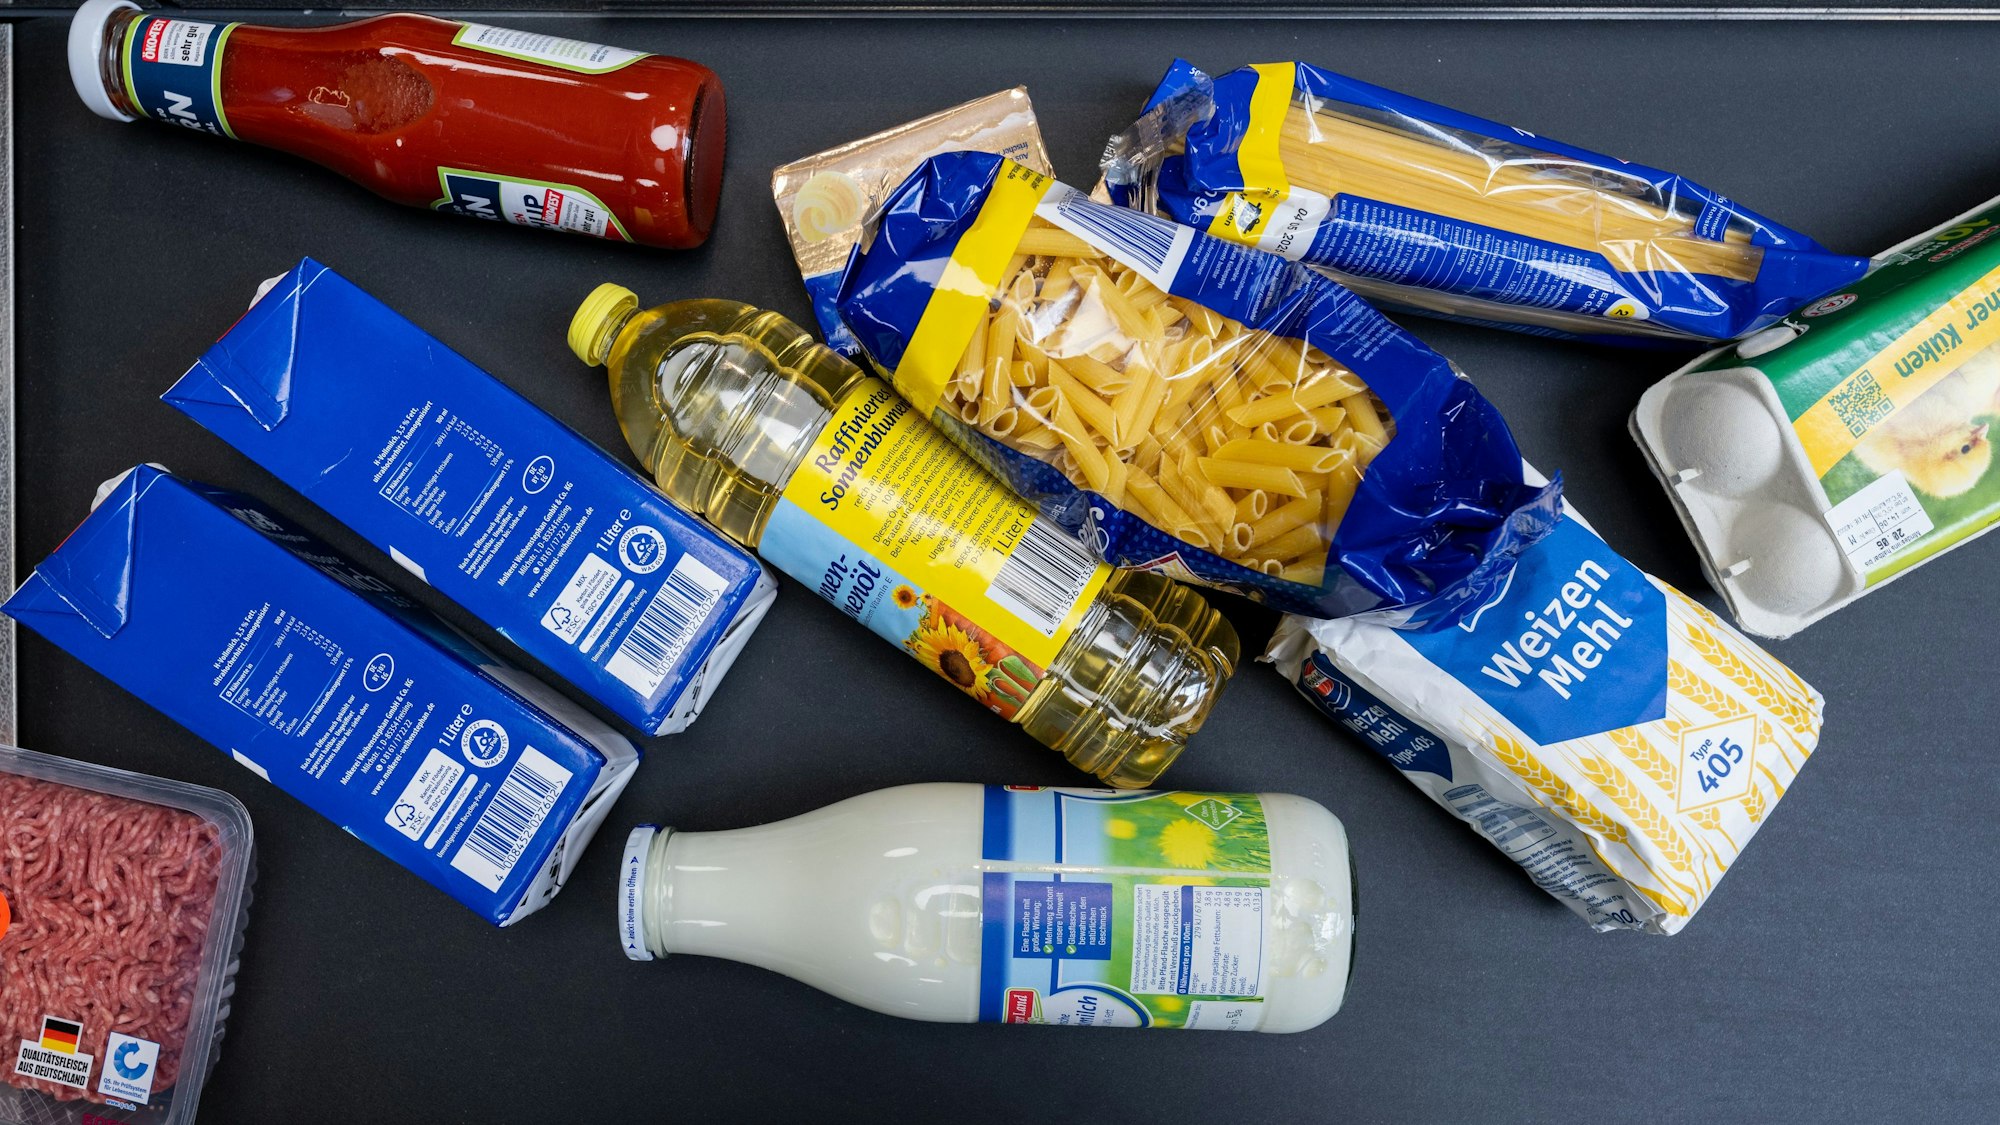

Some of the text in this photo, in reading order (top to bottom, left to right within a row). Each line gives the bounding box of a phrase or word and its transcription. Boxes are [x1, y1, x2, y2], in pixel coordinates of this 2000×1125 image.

[180, 25, 198, 60] sehr gut
[1292, 207, 1308, 221] 04
[1892, 322, 1963, 379] Küken
[813, 387, 891, 474] Raffiniertes
[528, 465, 537, 474] DE
[553, 503, 572, 527] Freising
[872, 517, 892, 543] Dieses
[909, 473, 922, 488] sich
[882, 518, 904, 547] Braten
[900, 501, 915, 519] und
[912, 485, 927, 503] zum
[889, 543, 902, 558] Bei
[937, 475, 949, 489] und
[910, 524, 927, 545] Nach
[934, 477, 960, 509] Gebrauch
[496, 559, 519, 587] Molkerei
[513, 519, 549, 563] Weihenstephan
[542, 503, 558, 522] GmbH
[558, 489, 568, 500] Co.
[563, 481, 573, 491] KG
[595, 517, 625, 553] 1 Liter
[969, 512, 995, 545] ZENTRALE
[992, 515, 1025, 556] 1 Liter
[527, 505, 595, 598] www.molkerei-weihenstephan.de
[575, 574, 587, 588] MIX
[595, 572, 617, 601] C014047
[1044, 627, 1053, 635] 4
[1075, 556, 1099, 587] 413256
[564, 614, 581, 635] FSC
[1479, 557, 1610, 687] Weizen
[647, 595, 715, 689] 4 008452 027602
[1537, 598, 1633, 700] Mehl
[394, 700, 414, 723] Freising
[1341, 704, 1388, 733] Weizen
[339, 758, 361, 786] Molkerei
[356, 716, 390, 762] Weihenstephan
[384, 700, 401, 719] GmbH
[399, 686, 408, 696] Co.
[404, 677, 414, 688] KG
[437, 712, 466, 748] 1 Liter
[1366, 717, 1407, 745] Mehl
[1387, 733, 1435, 763] Type 405
[370, 701, 437, 796] www.molkerei-weihenstephan.de
[1689, 738, 1712, 761] Type
[1698, 737, 1744, 792] 405
[419, 769, 431, 783] MIX
[439, 767, 460, 796] C014047
[408, 810, 426, 831] FSC
[493, 788, 560, 882] 4 008452 027602
[1021, 911, 1029, 936] Flasche
[1045, 886, 1053, 944] Mehrweg schont
[1068, 901, 1076, 944] Glasflaschen
[1078, 911, 1086, 944] bewahren
[1088, 907, 1096, 944] natürlichen
[1098, 906, 1106, 944] Geschmack
[1021, 938, 1029, 951] Eine
[1159, 930, 1168, 975] Pfand-Flasche
[1012, 994, 1027, 1015] Land
[17, 1061, 85, 1086] AUS DEUTSCHLAND
[21, 1046, 88, 1073] QUALITÄTSFLEISCH
